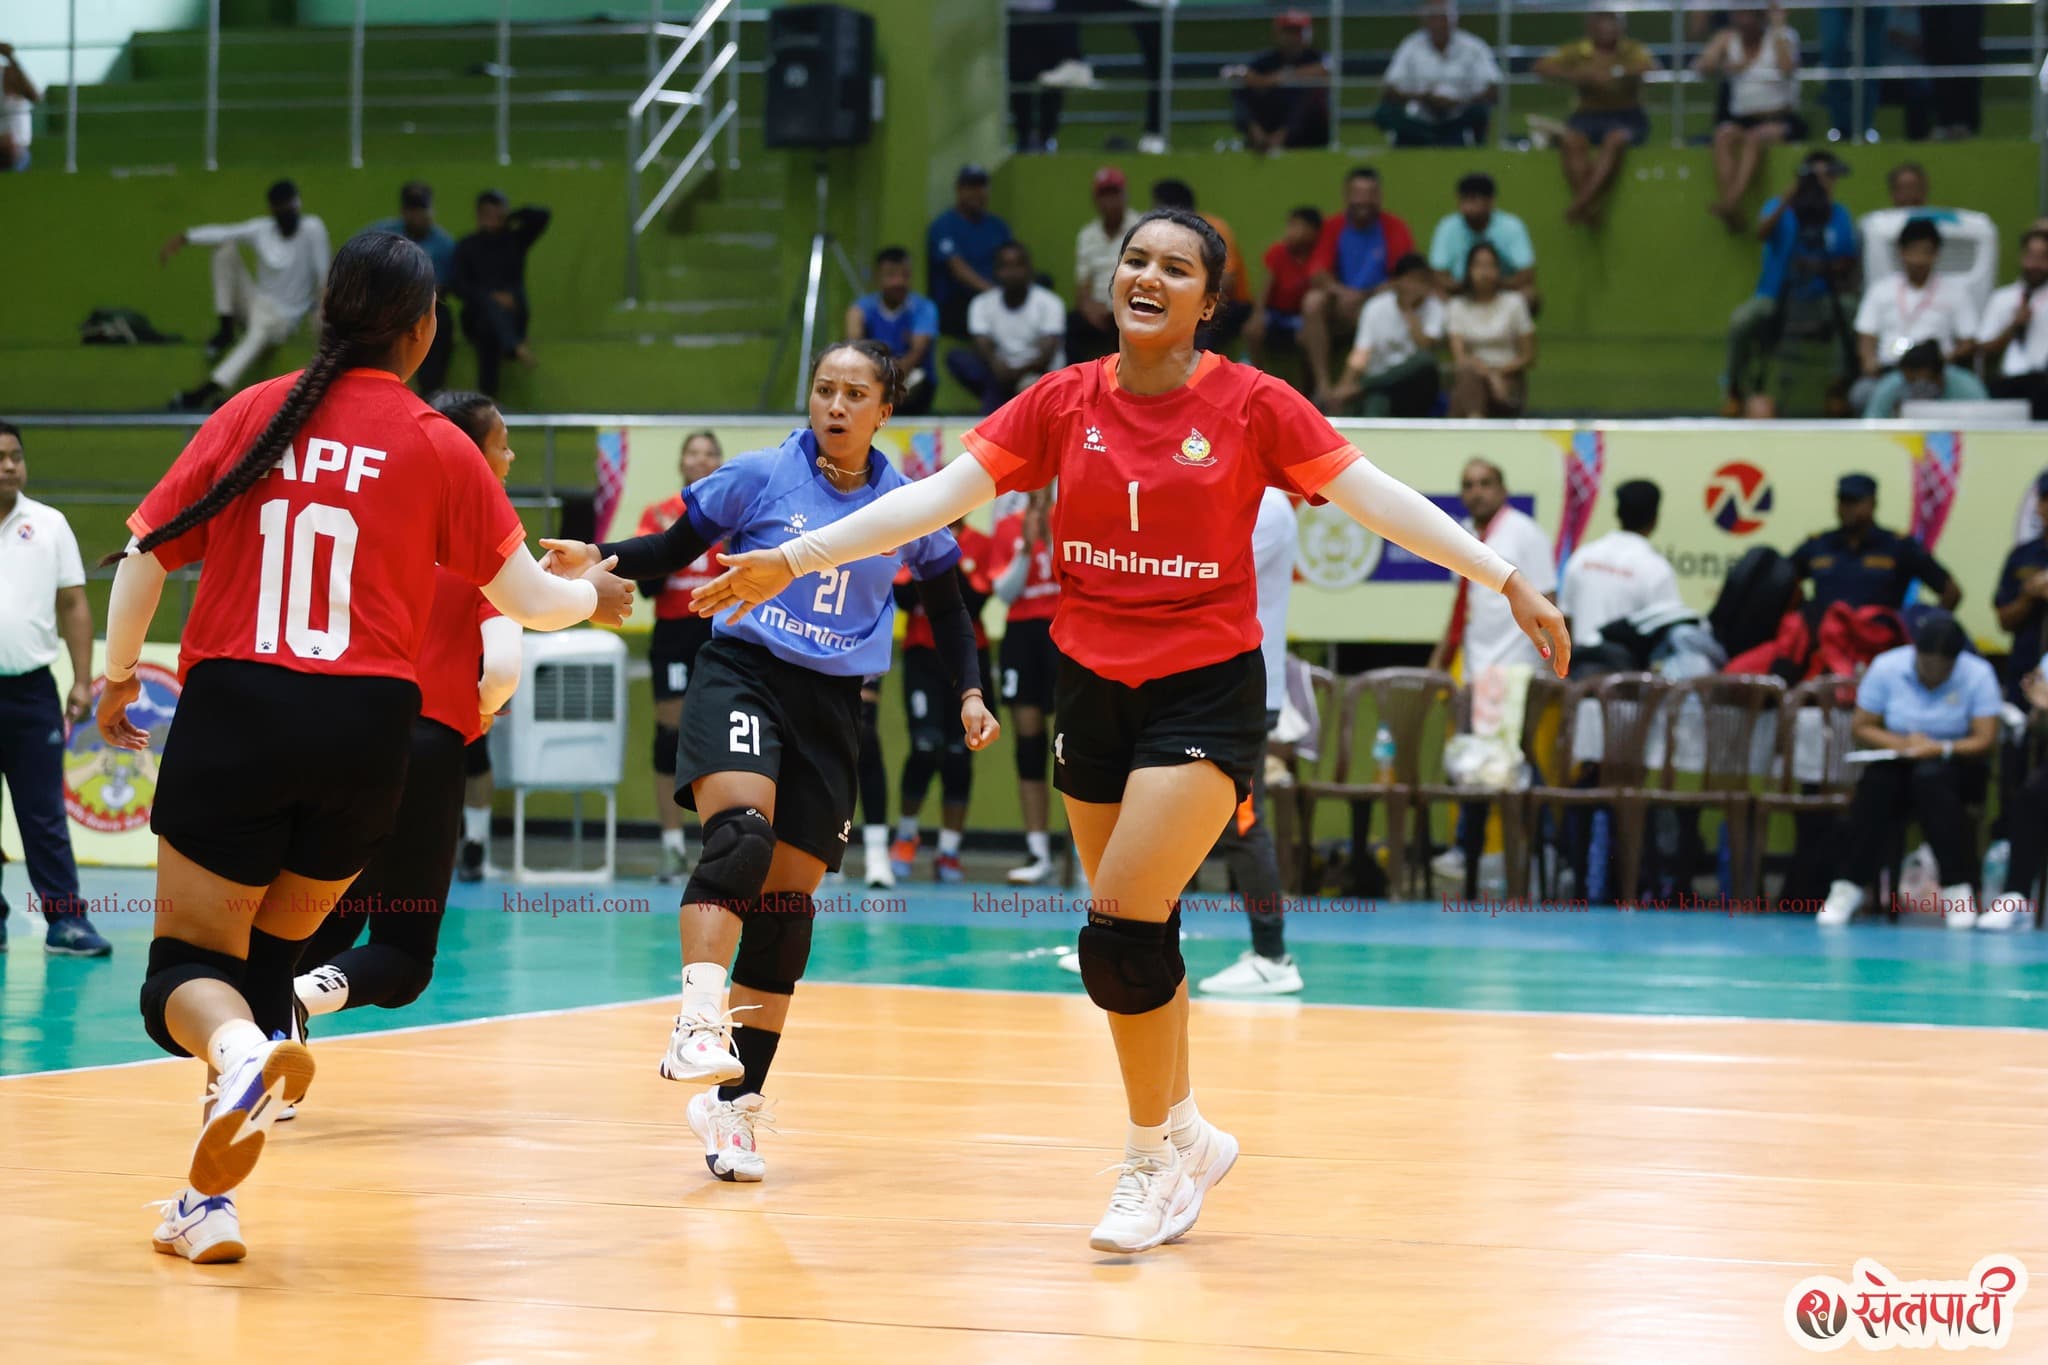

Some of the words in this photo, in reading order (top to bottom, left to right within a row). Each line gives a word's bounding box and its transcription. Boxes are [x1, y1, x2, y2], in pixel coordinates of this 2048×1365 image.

[258, 437, 387, 493] APF
[1083, 442, 1107, 453] ELME
[1127, 480, 1140, 532] 1
[254, 498, 359, 661] 10
[1062, 540, 1220, 579] Mahindra
[812, 567, 850, 616] 21
[759, 604, 865, 650] Mahind
[729, 710, 761, 757] 21
